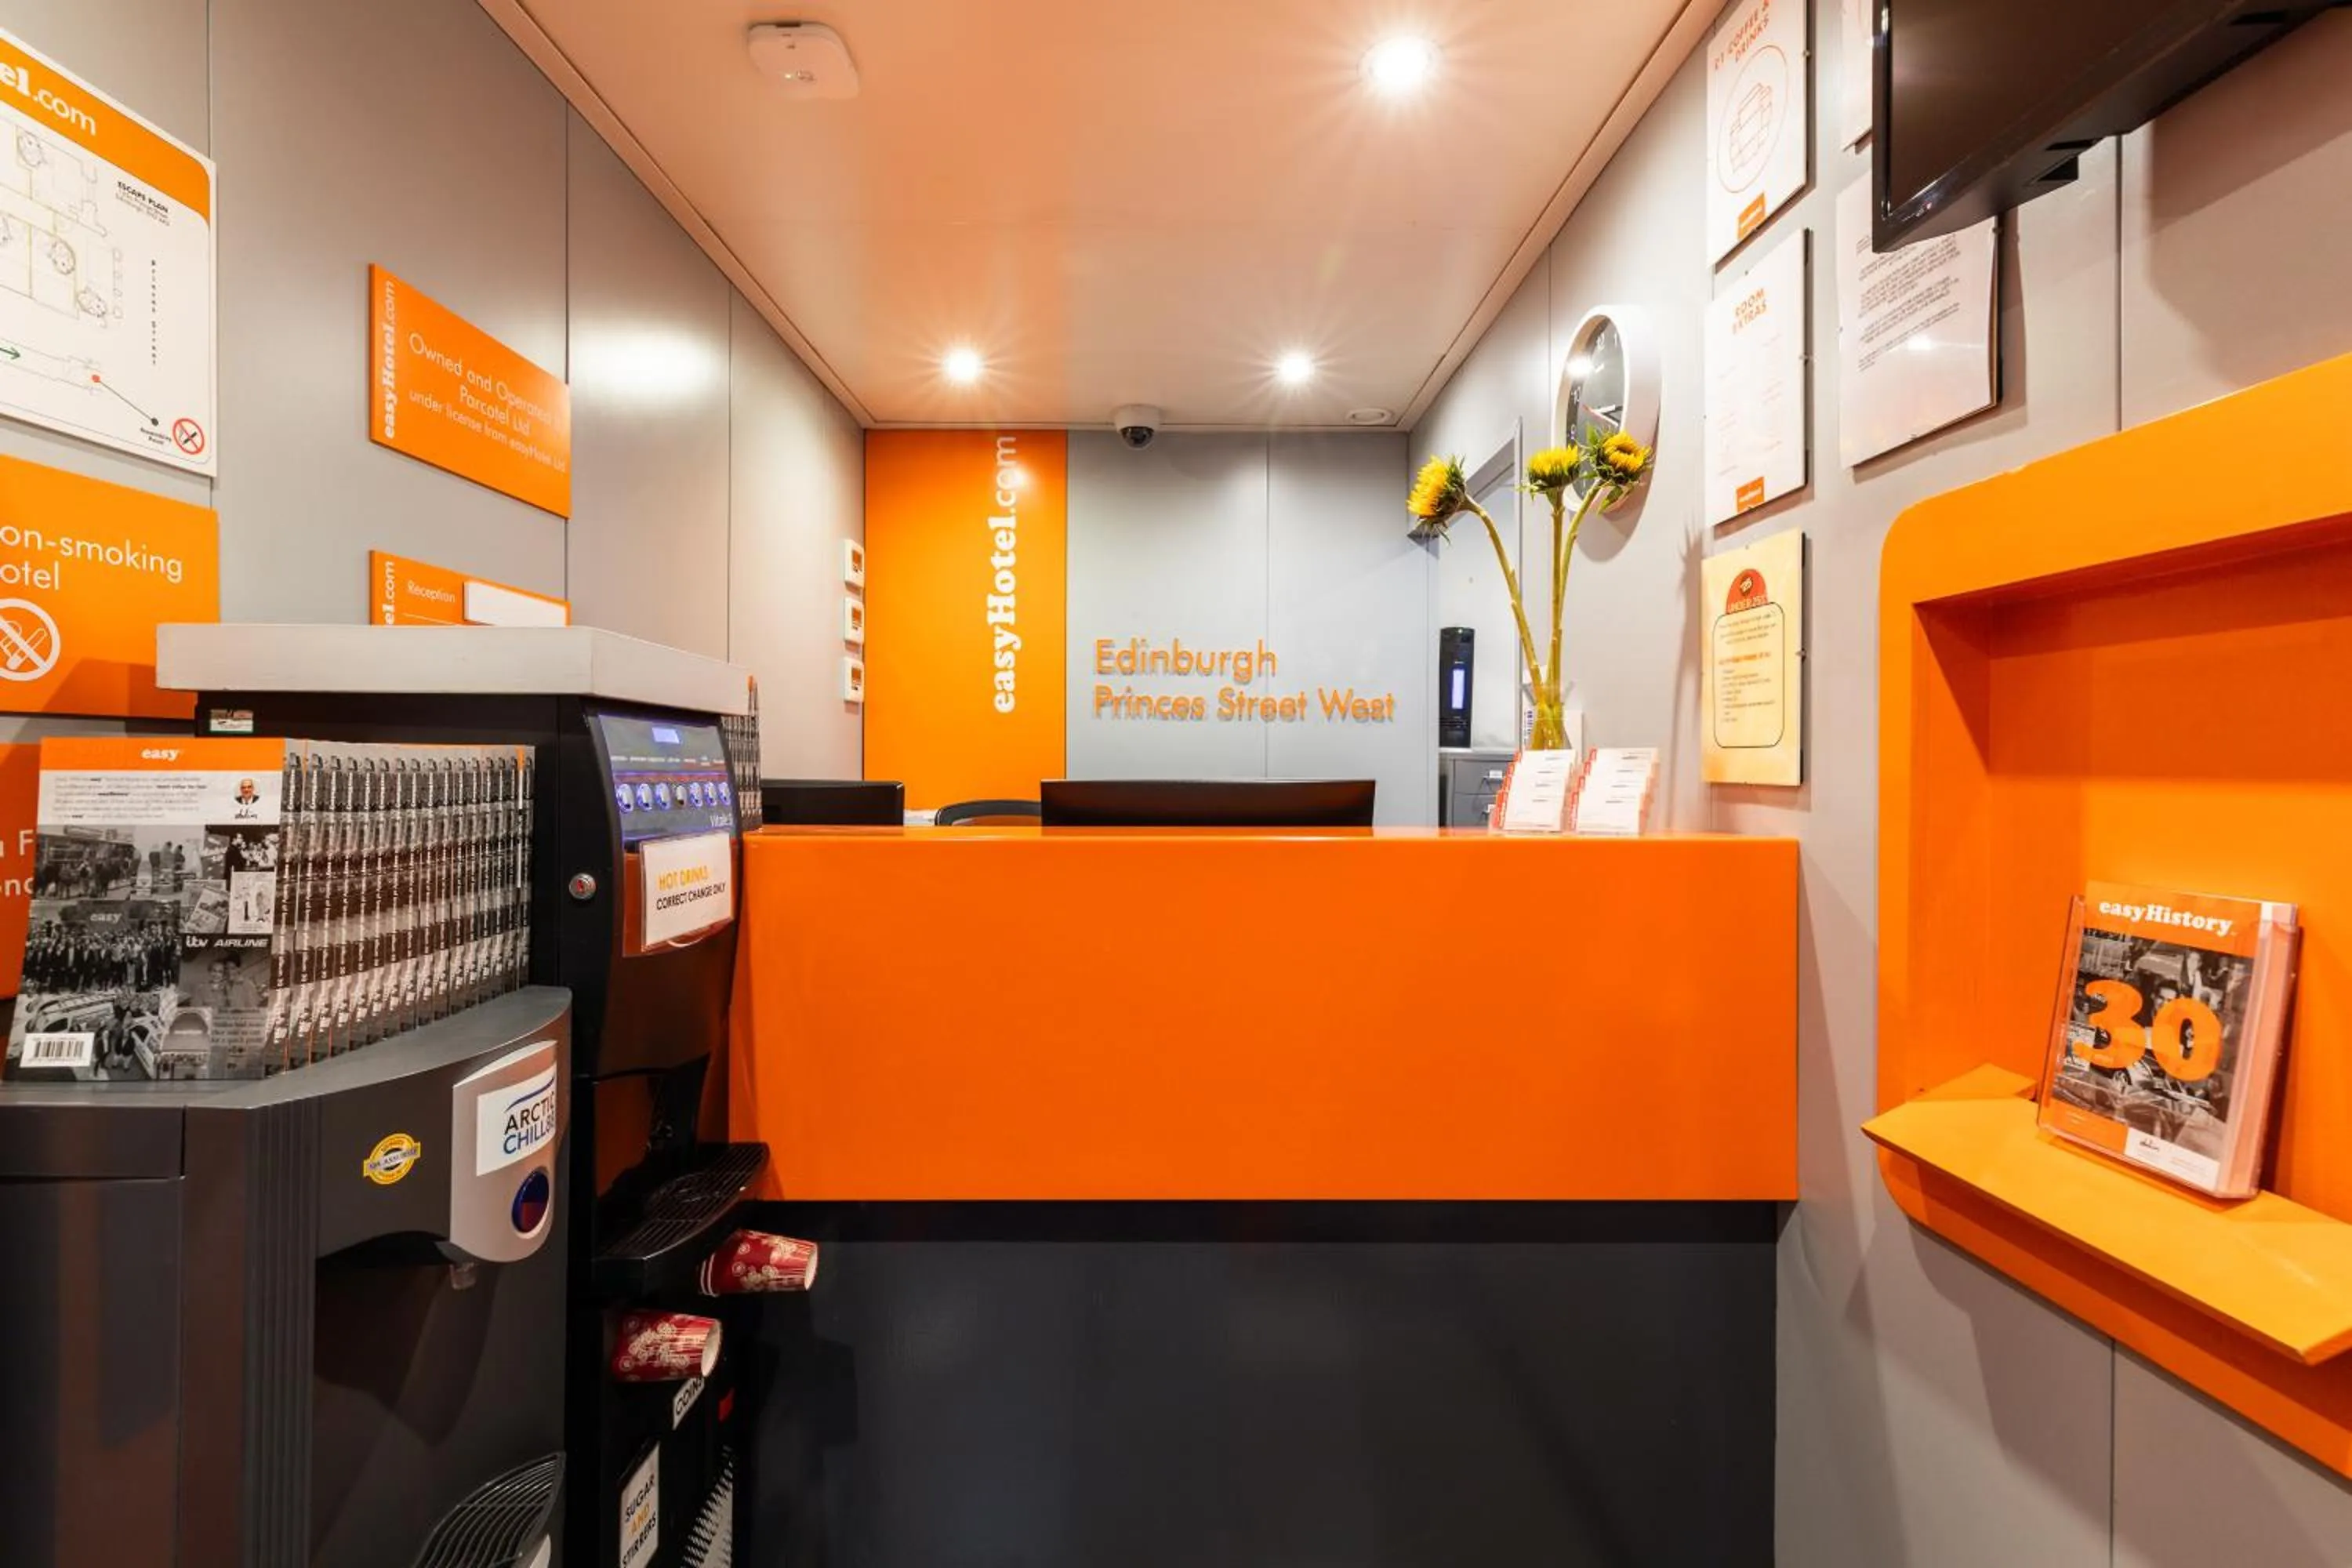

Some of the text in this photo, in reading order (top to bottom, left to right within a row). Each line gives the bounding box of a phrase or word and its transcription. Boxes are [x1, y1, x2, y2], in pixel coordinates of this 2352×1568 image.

[382, 280, 398, 439] easyHotel.com
[408, 332, 463, 376] Owned
[467, 370, 492, 392] and
[409, 390, 443, 413] under
[459, 385, 510, 426] Parcotel
[408, 579, 456, 603] Reception
[987, 436, 1022, 713] easyHotel.com
[1094, 638, 1278, 684] Edinburgh
[1094, 685, 1395, 722] Princes Street West
[141, 748, 180, 762] easy
[659, 872, 679, 891] HOT
[656, 891, 687, 910] CORRECT
[2099, 901, 2233, 937] easyHistory
[213, 938, 269, 948] AIRLINE
[2071, 978, 2223, 1081] 30
[626, 1473, 655, 1523] SUGAR
[629, 1502, 650, 1538] AND
[622, 1511, 657, 1568] STIRRERS
